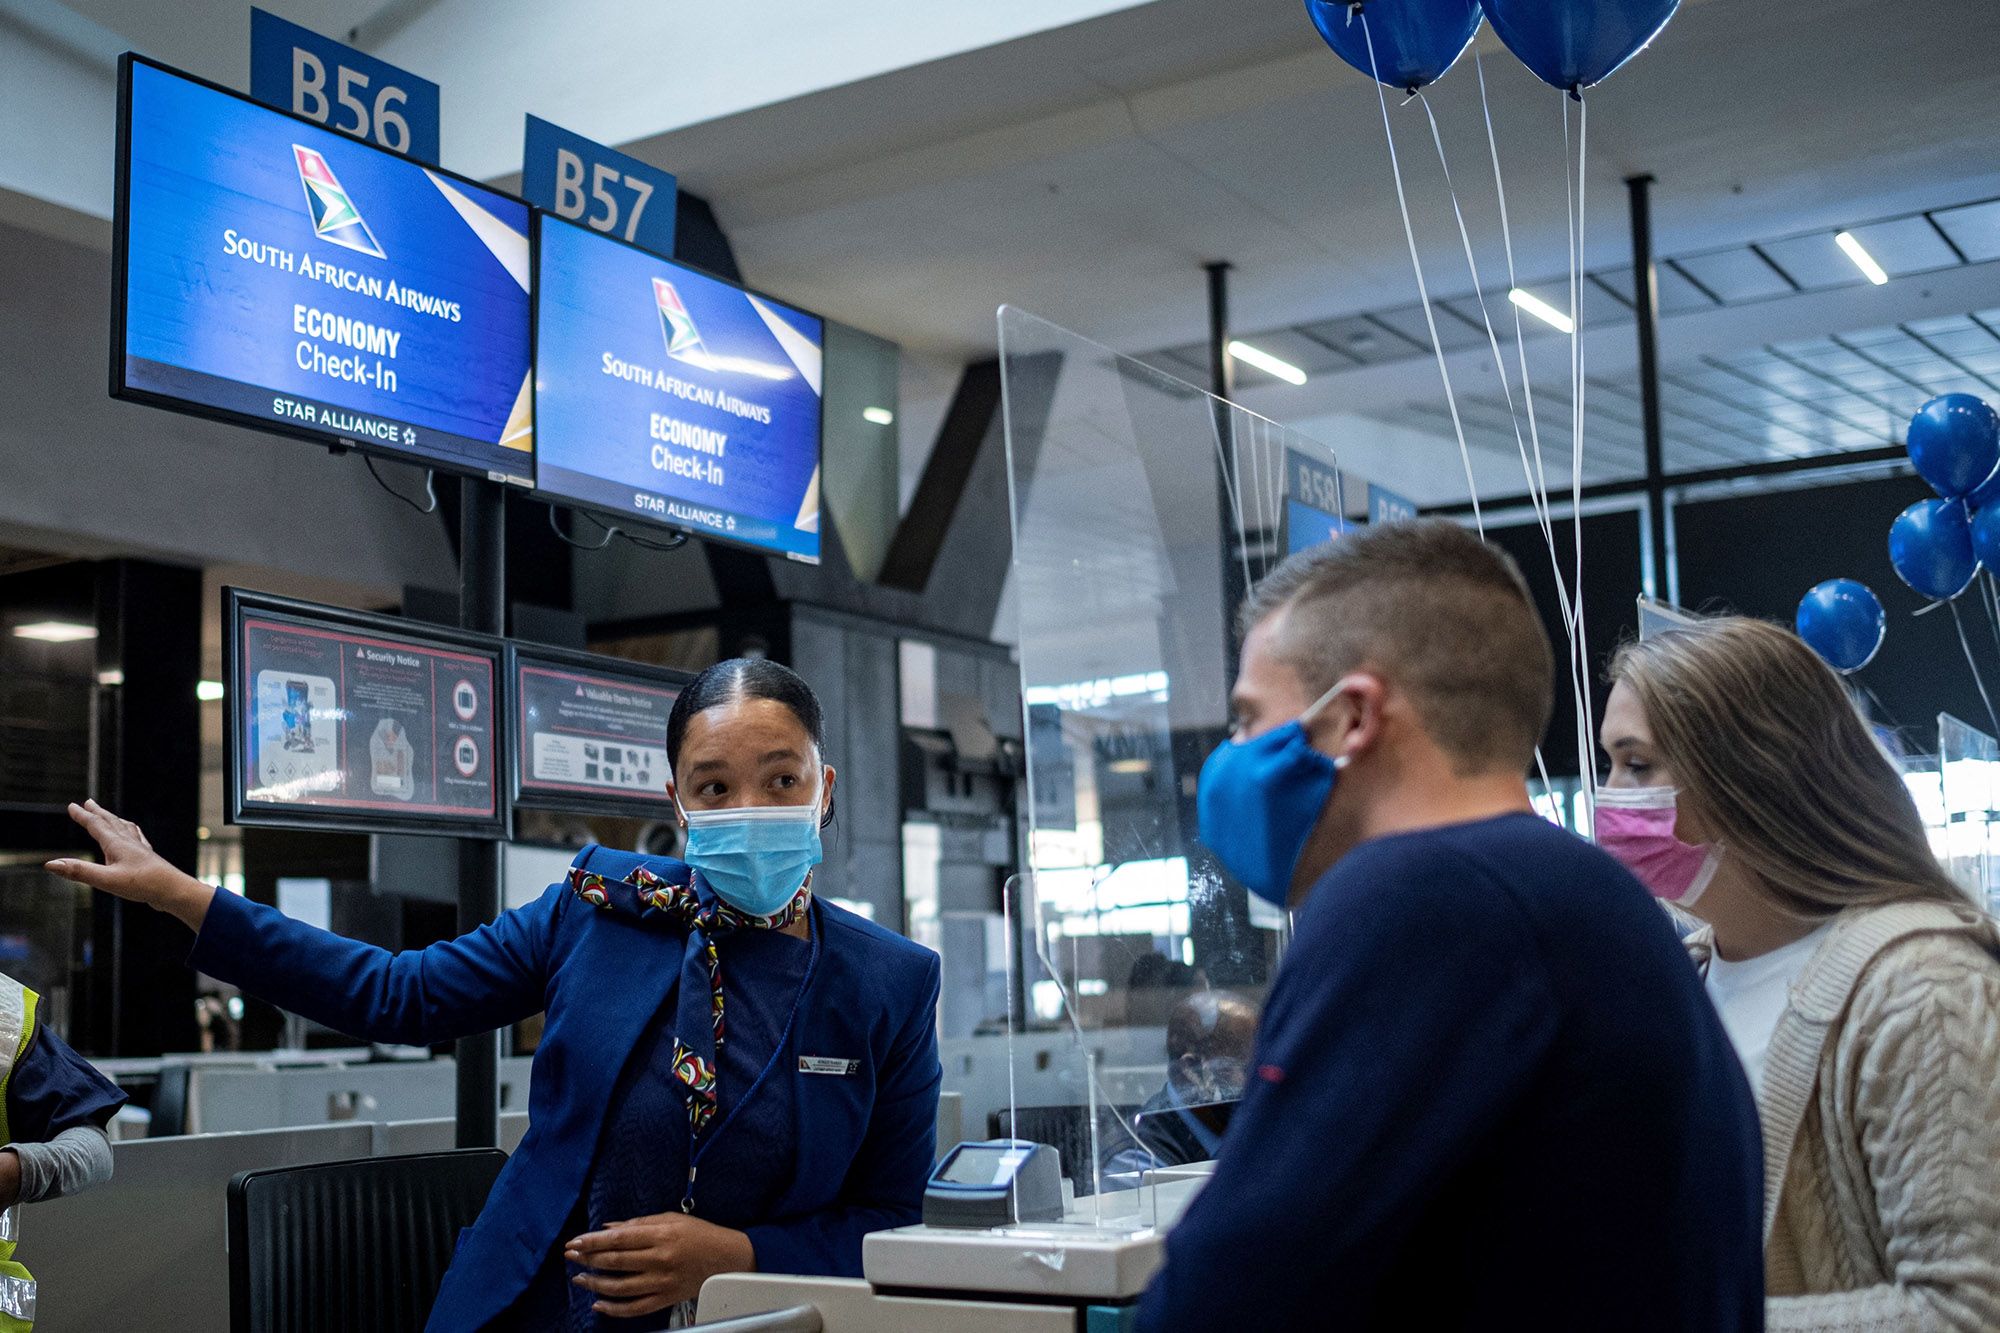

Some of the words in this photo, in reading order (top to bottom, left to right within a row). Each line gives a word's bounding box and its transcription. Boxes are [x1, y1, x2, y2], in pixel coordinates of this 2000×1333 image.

[292, 46, 411, 154] B56
[554, 147, 655, 243] B57
[223, 229, 294, 272] SOUTH
[298, 253, 382, 299] AFRICAN
[385, 279, 462, 323] AIRWAYS
[293, 303, 401, 359] ECONOMY
[296, 341, 397, 392] Check-In
[602, 352, 651, 387] SOUTH
[654, 370, 714, 407] AFRICAN
[716, 390, 771, 425] AIRWAYS
[273, 398, 316, 422] STAR
[320, 409, 398, 442] ALLIANCE
[650, 413, 727, 457] ECONOMY
[651, 444, 724, 486] Check-In
[634, 493, 665, 514] STAR
[667, 502, 723, 529] ALLIANCE
[366, 649, 395, 666] Security
[396, 654, 420, 668] Notice
